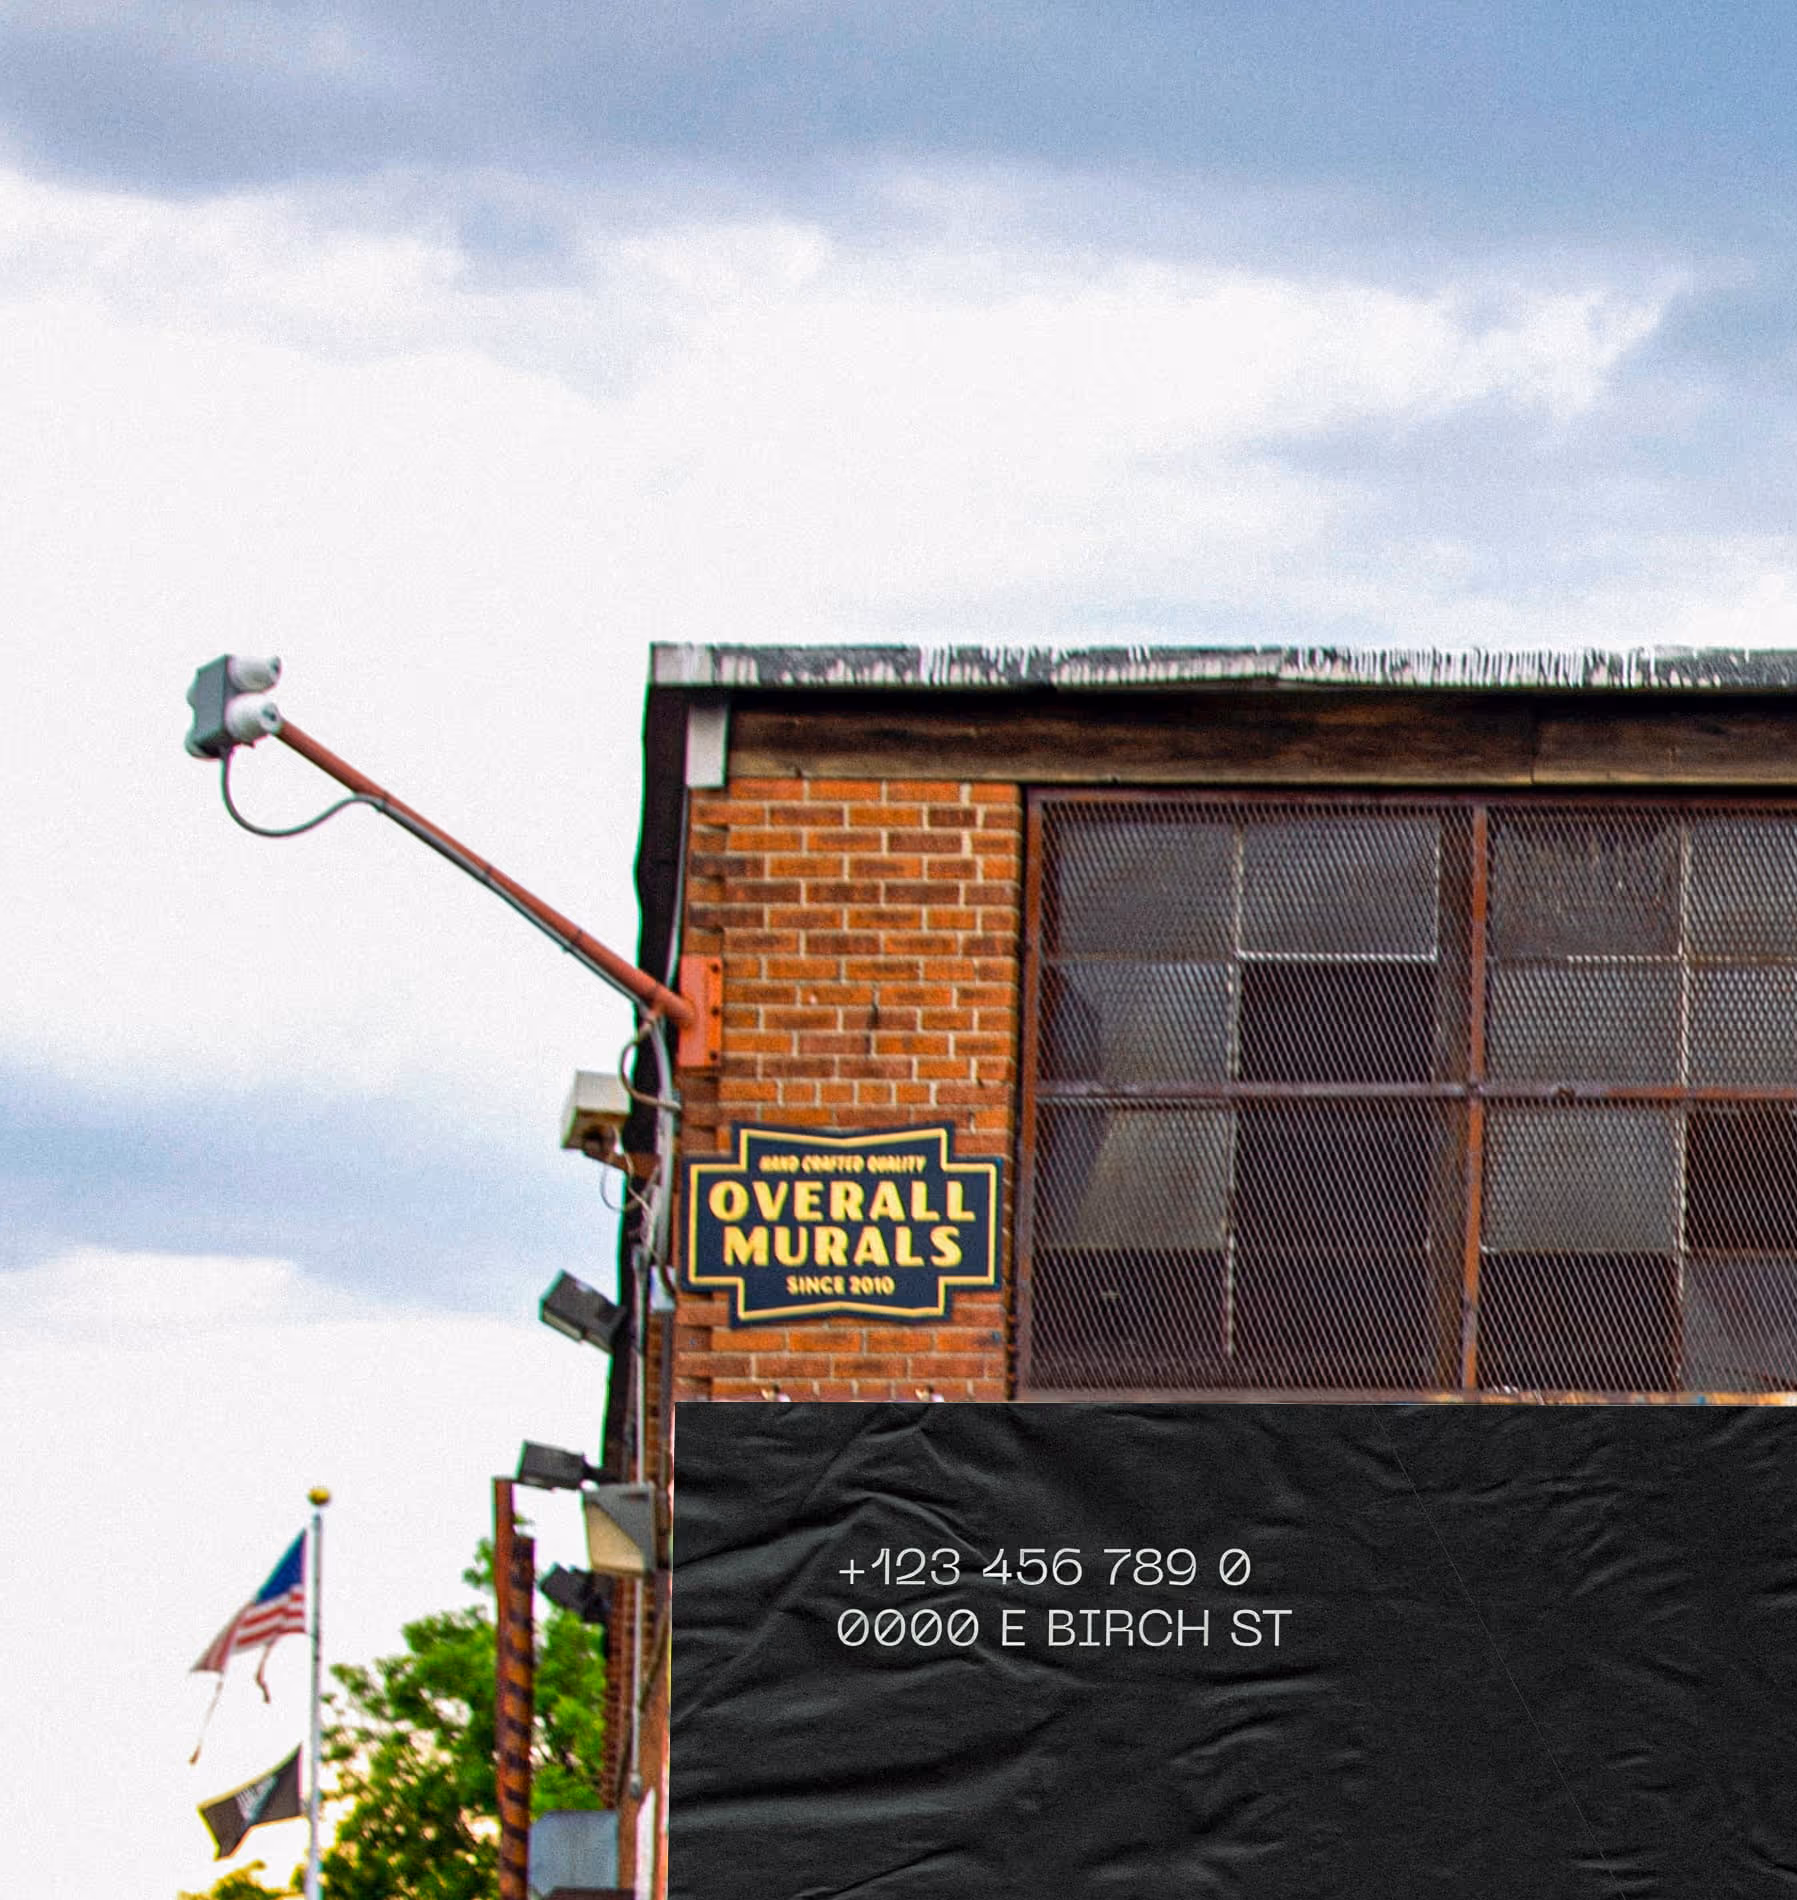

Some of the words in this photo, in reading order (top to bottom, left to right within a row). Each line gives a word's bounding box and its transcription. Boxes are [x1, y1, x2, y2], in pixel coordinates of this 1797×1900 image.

[708, 1180, 976, 1222] OVERALL
[722, 1225, 963, 1268] MURALS
[786, 1275, 845, 1296] SINCE
[848, 1275, 896, 1296] 2010
[838, 1547, 960, 1586] +123
[982, 1547, 1083, 1586] 456
[1103, 1548, 1197, 1586] 789
[1218, 1548, 1251, 1586] 0
[837, 1608, 979, 1647] 0000
[1001, 1609, 1026, 1647] E
[1048, 1609, 1209, 1647] BIRCH
[1230, 1608, 1293, 1647] ST
